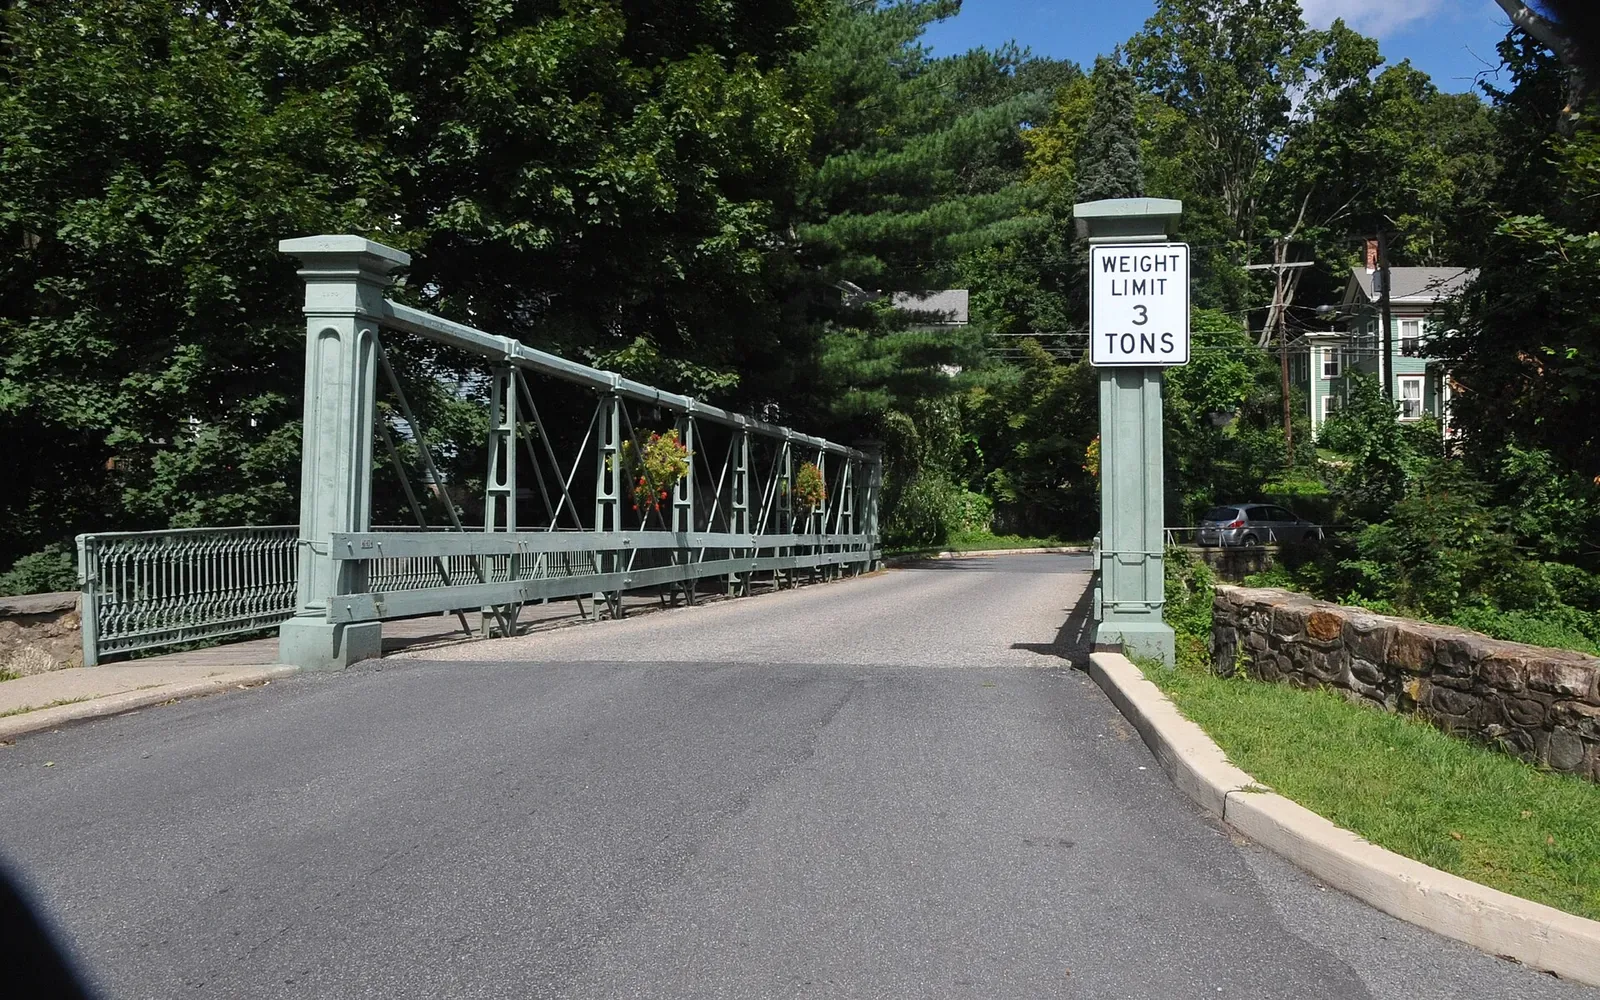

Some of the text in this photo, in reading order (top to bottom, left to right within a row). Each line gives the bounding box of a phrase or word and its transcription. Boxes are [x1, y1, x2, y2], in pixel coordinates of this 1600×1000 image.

[1102, 254, 1180, 273] WEIGHT
[1111, 278, 1168, 296] LIMIT
[1131, 304, 1148, 326] 3
[1104, 332, 1175, 354] TONS
